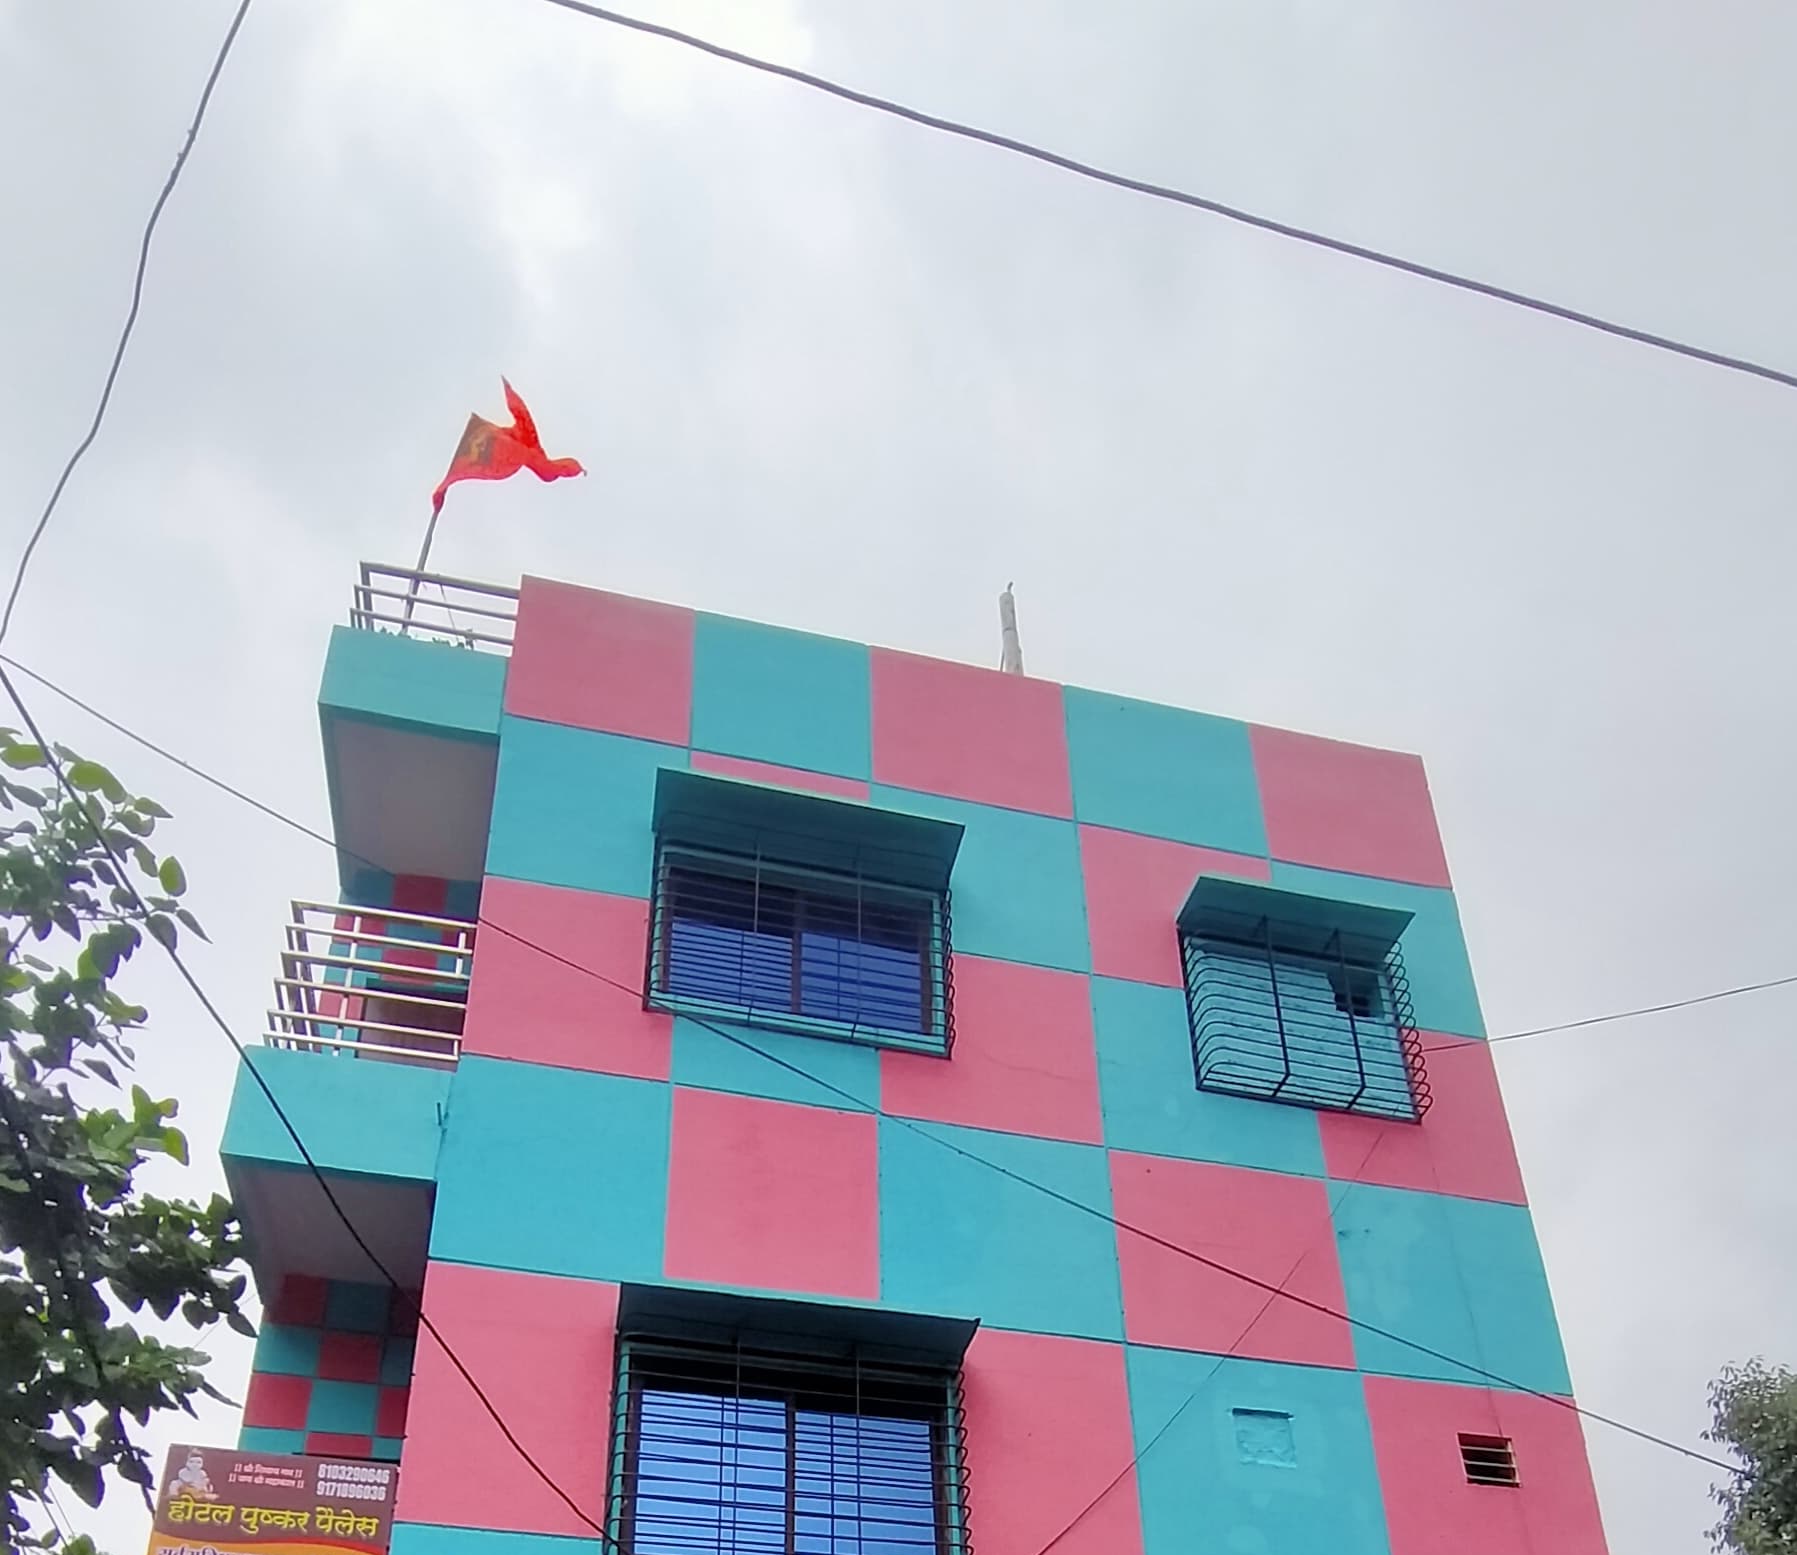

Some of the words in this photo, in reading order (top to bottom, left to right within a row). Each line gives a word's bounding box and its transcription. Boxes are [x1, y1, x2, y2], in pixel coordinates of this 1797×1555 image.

[168, 1495, 235, 1523] होटल
[240, 1507, 310, 1534] पुष्कर
[316, 1506, 379, 1537] पैलेस
